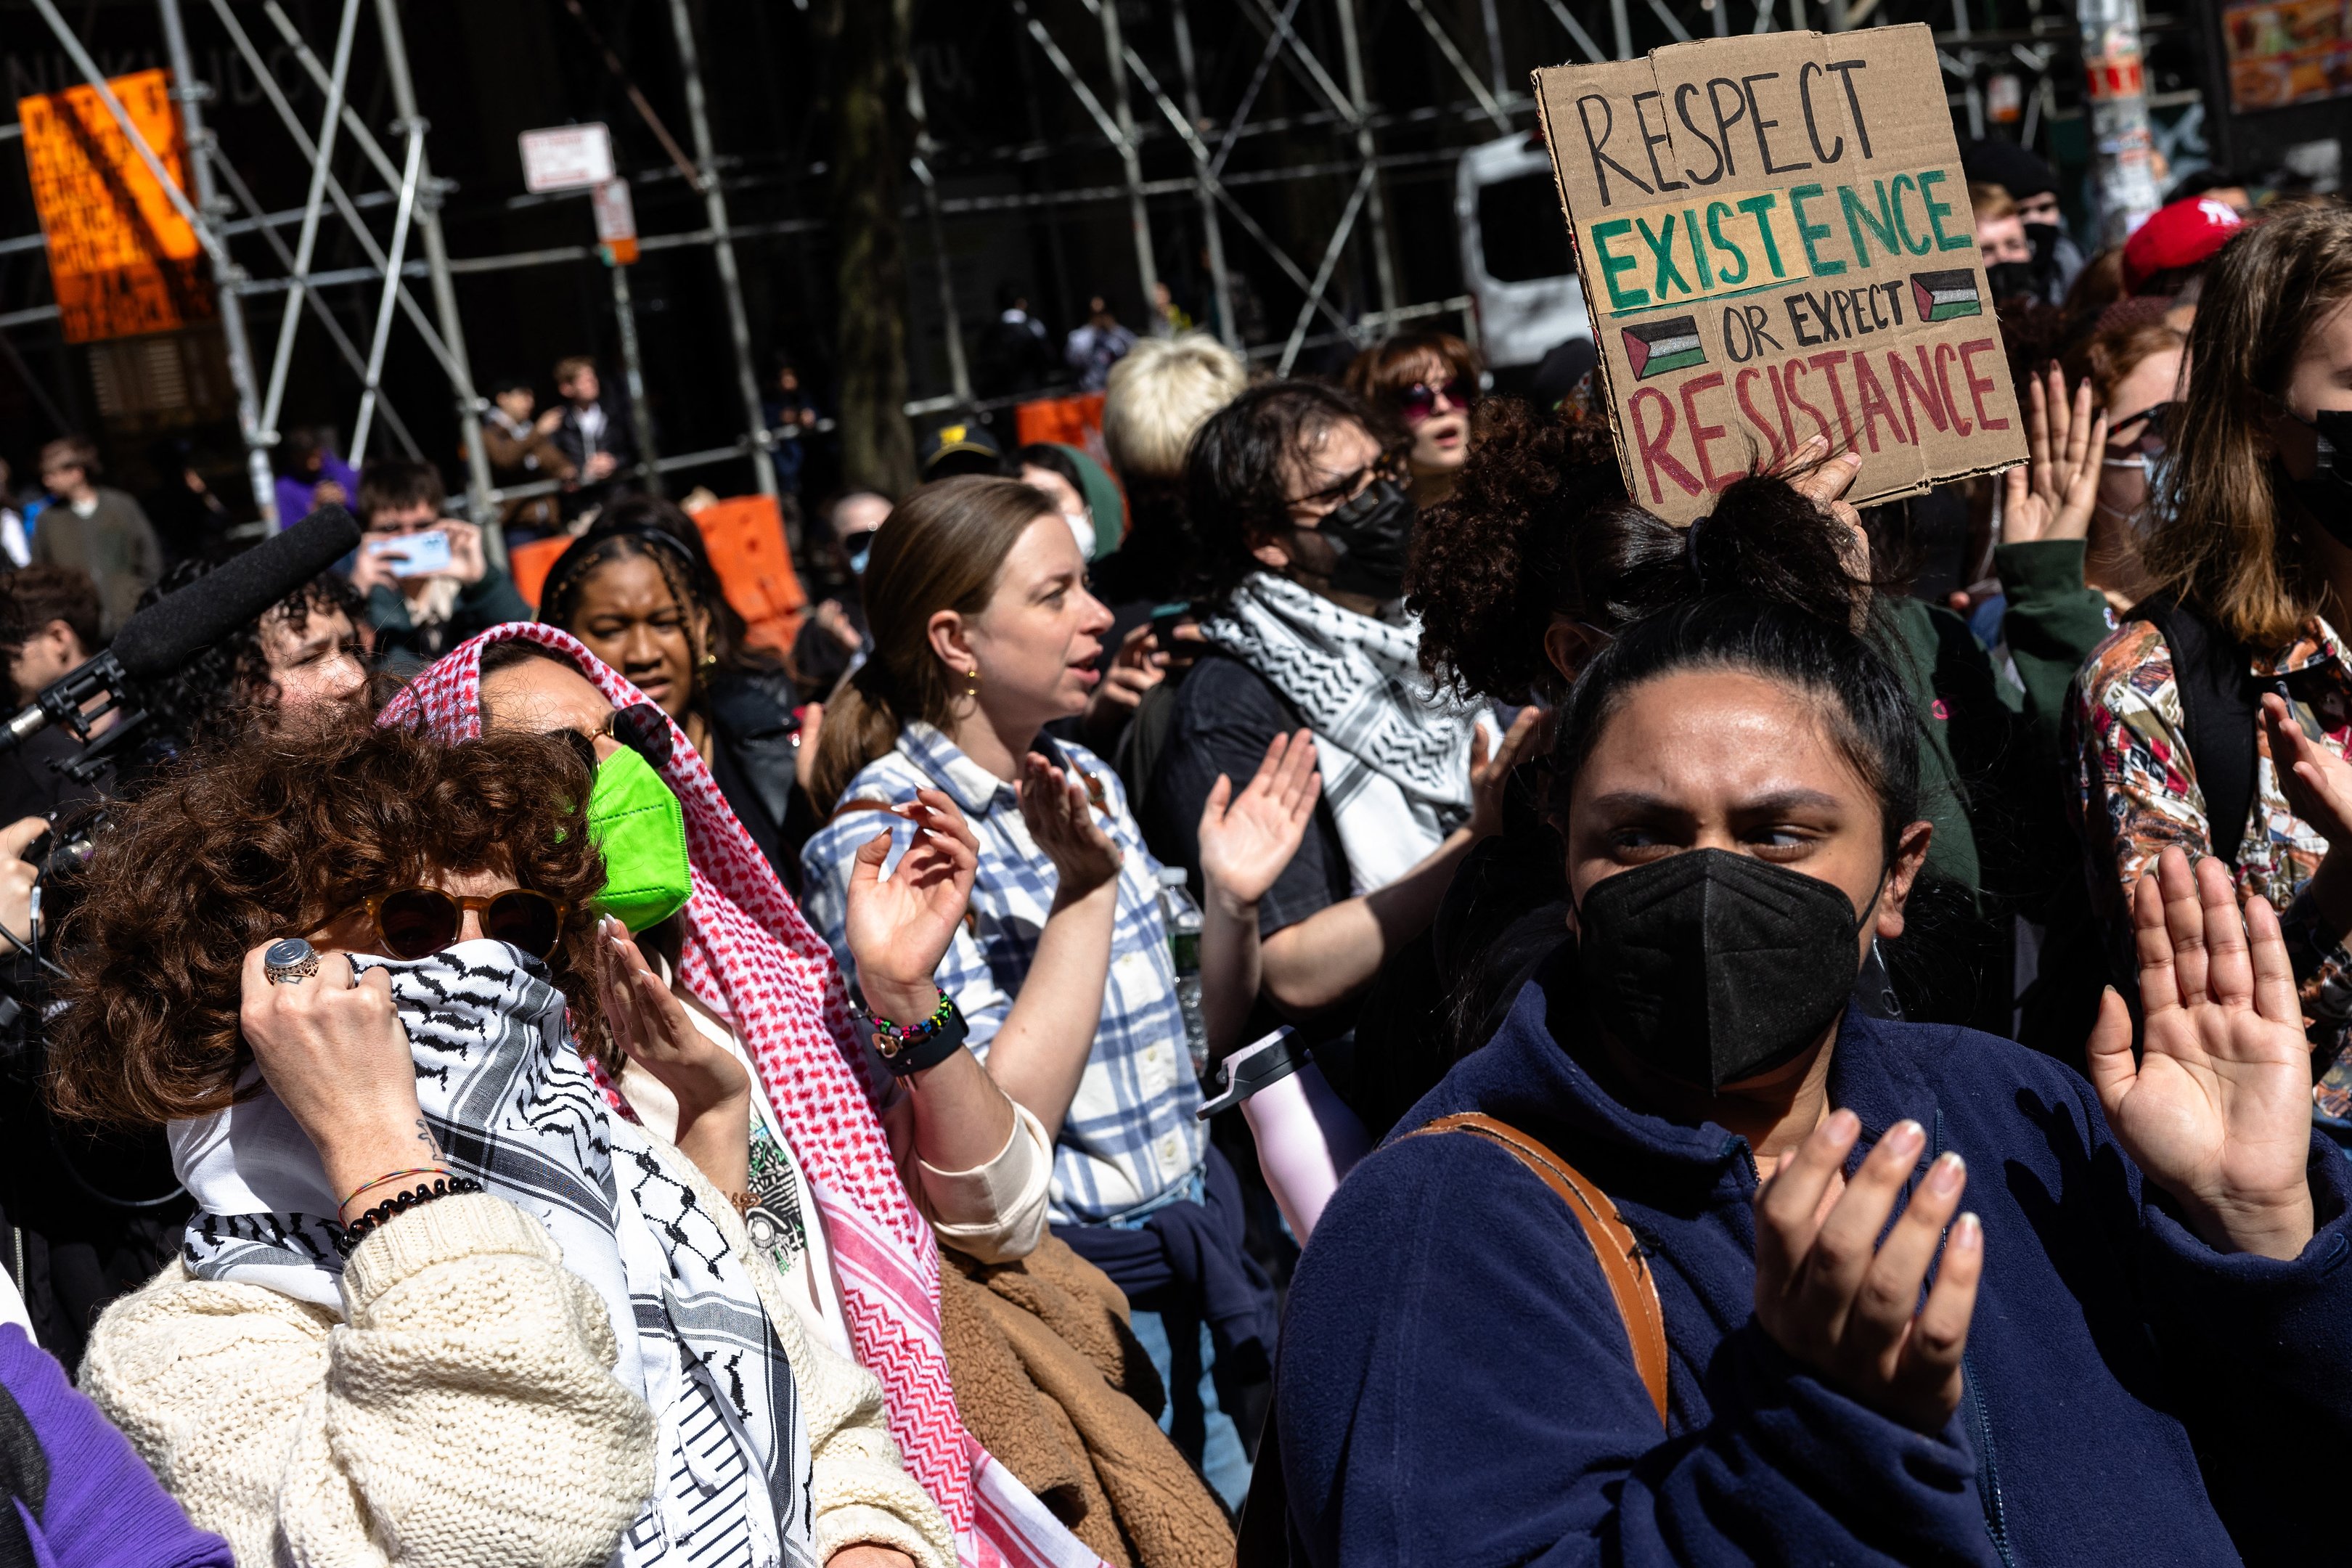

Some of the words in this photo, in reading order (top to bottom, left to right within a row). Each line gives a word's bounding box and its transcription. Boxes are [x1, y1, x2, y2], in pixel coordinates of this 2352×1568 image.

[1577, 60, 1873, 207] RESPECT
[1591, 170, 1972, 310] EXISTENCE
[1723, 305, 1784, 362] OR
[1784, 280, 1905, 347] EXPECT
[1628, 338, 2009, 504] RESISTANCE
